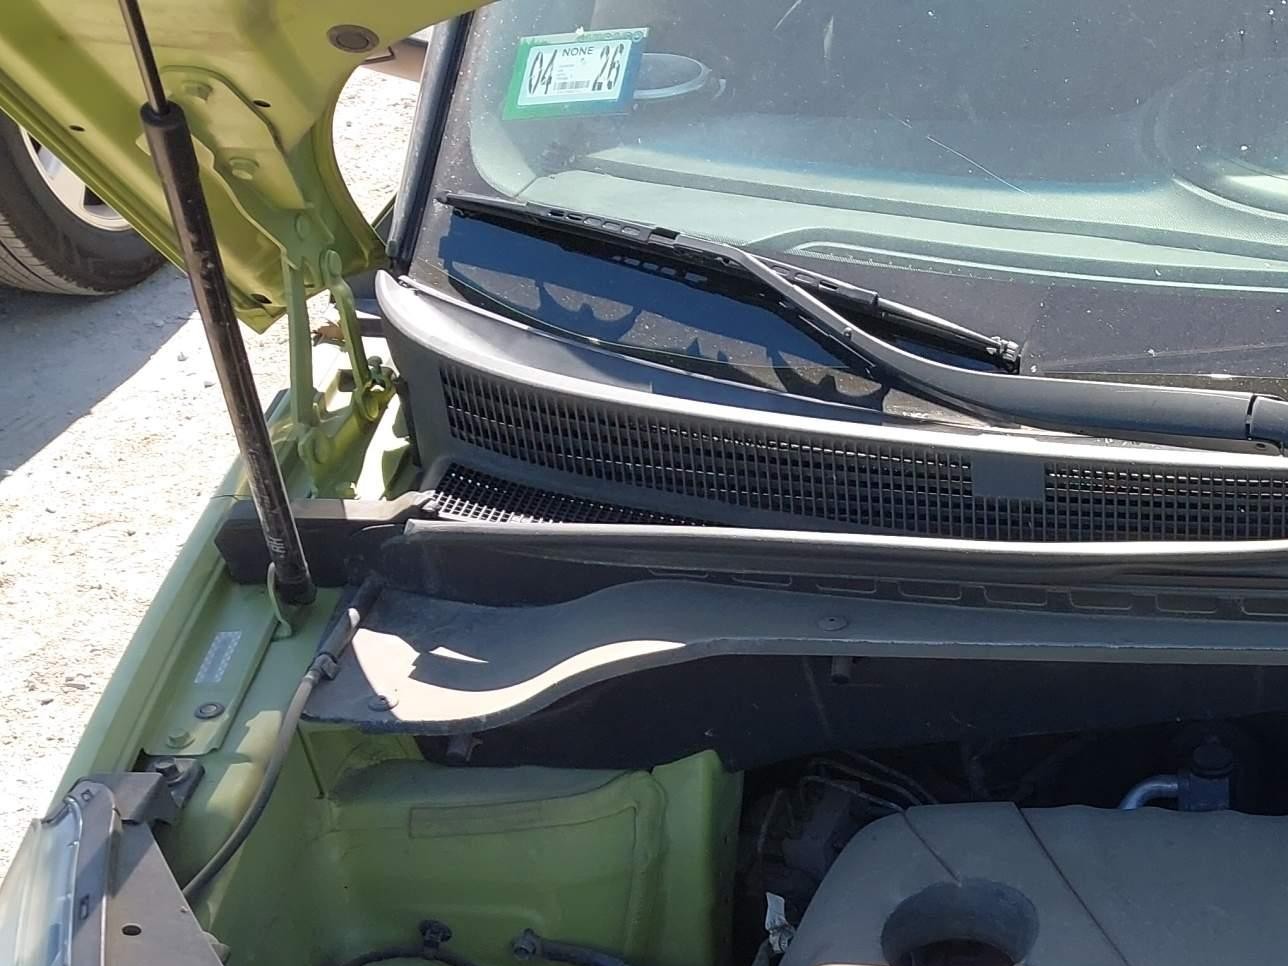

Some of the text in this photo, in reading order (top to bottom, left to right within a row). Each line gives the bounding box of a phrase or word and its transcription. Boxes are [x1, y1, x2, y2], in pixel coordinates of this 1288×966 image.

[562, 46, 594, 57] NONE
[529, 43, 624, 95] 04 26
